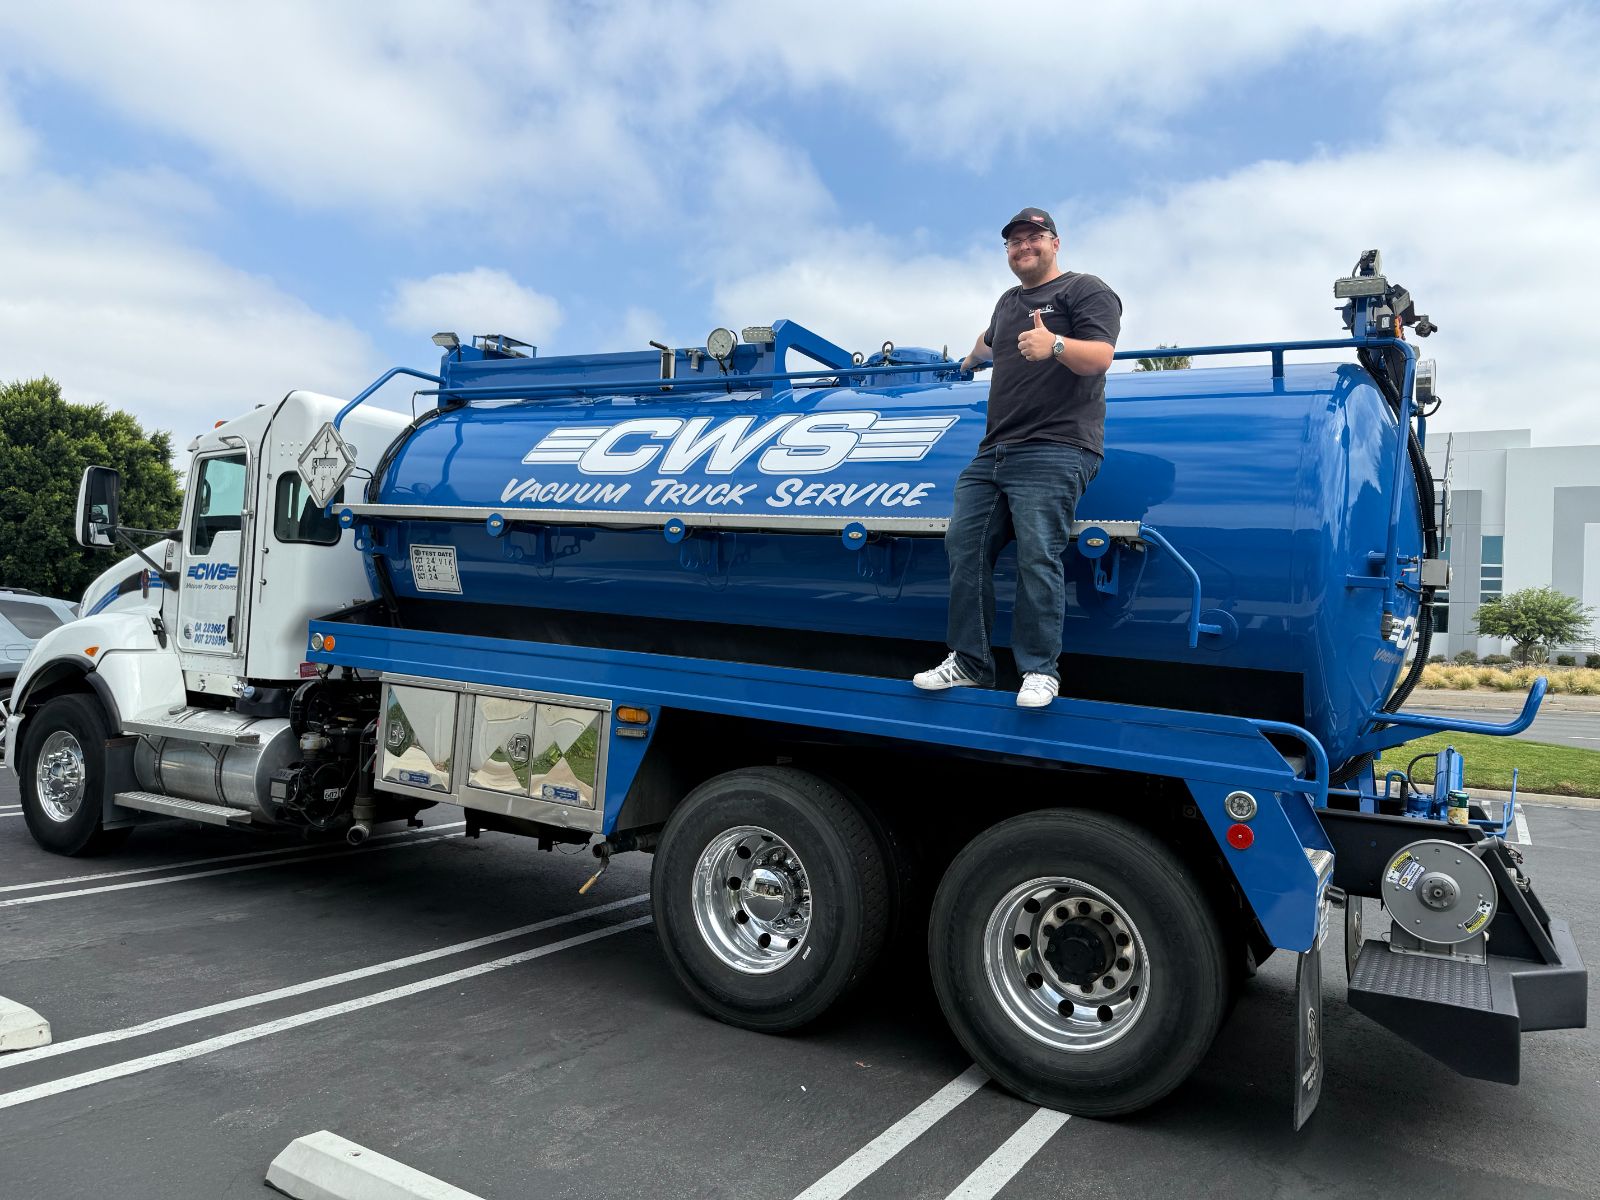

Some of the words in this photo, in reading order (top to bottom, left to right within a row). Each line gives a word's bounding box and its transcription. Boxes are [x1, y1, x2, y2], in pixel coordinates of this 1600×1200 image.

[578, 411, 881, 475] CWS
[500, 477, 632, 503] VACUUM
[644, 479, 758, 506] TRUCK
[765, 478, 936, 507] SERVICE
[194, 563, 230, 580] CWS
[194, 633, 204, 643] DOT
